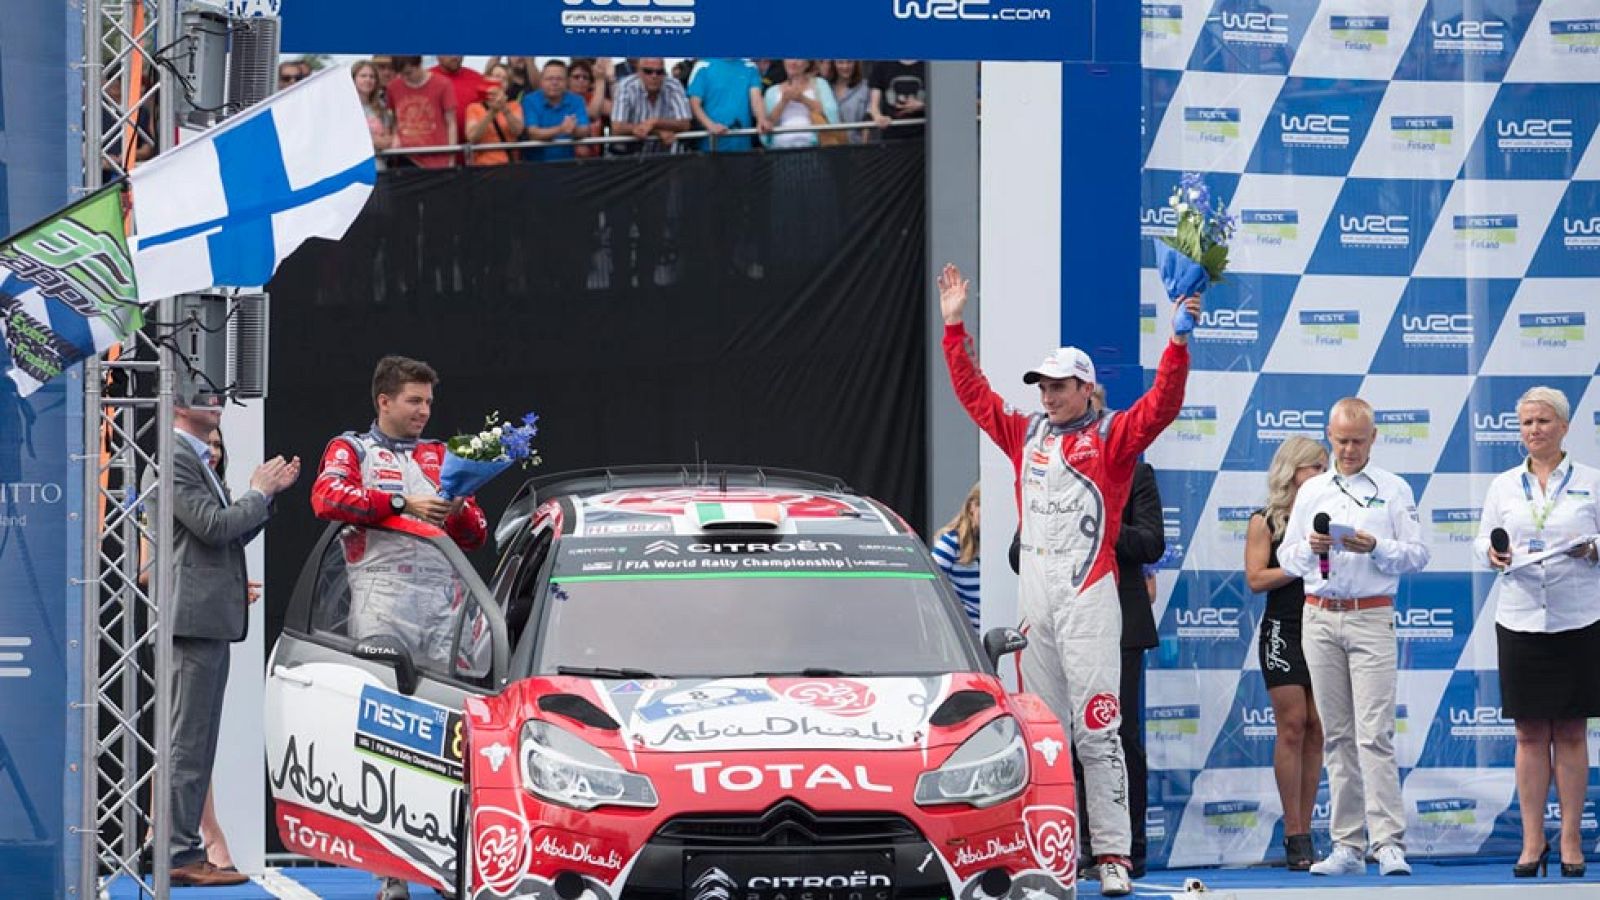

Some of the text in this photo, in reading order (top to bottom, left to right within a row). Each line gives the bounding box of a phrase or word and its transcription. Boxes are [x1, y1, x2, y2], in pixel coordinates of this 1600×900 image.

[1222, 11, 1289, 31] WRC
[1432, 20, 1505, 39] WRC
[1281, 113, 1351, 132] WRC
[1497, 119, 1573, 138] WRC
[1339, 214, 1410, 234] WRC
[1402, 313, 1475, 332] WRC
[1256, 409, 1325, 428] WRC
[687, 540, 843, 553] CITROËN
[625, 560, 649, 569] FIA
[654, 559, 697, 569] World
[701, 558, 737, 569] Rally
[742, 557, 846, 569] Championship
[1176, 608, 1239, 625] WRC
[362, 645, 398, 655] TOTAL
[364, 699, 432, 740] NESTE
[676, 761, 894, 794] TOTAL
[283, 814, 364, 864] TOTAL
[747, 870, 892, 888] CITROËN
